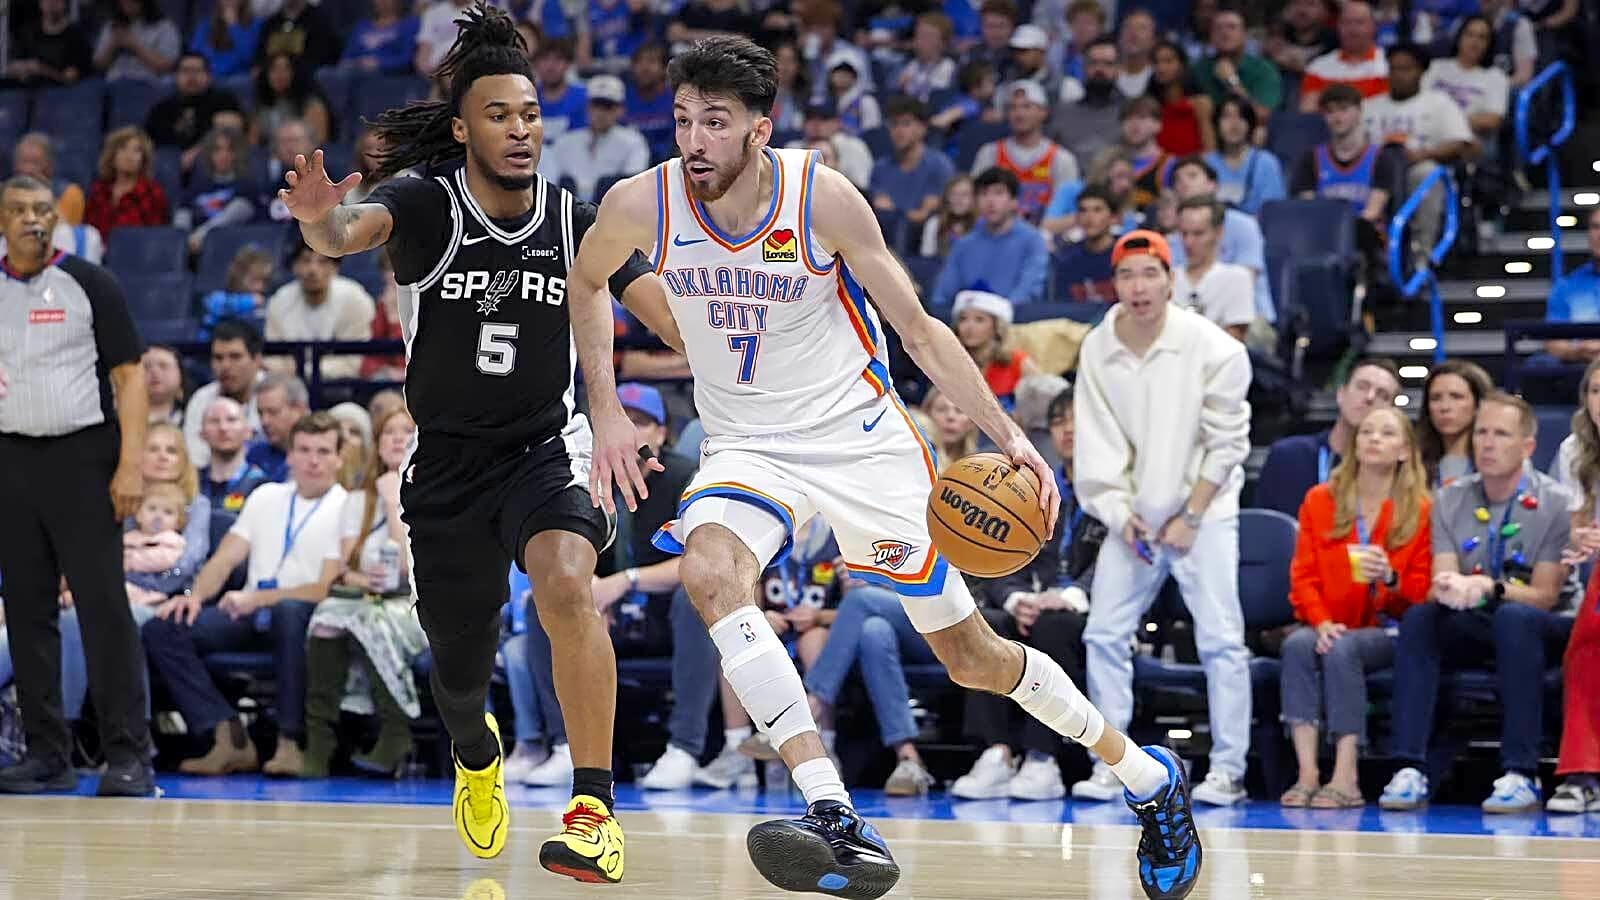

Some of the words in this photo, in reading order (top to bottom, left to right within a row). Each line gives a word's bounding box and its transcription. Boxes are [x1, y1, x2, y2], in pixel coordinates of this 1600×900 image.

[526, 249, 554, 257] LEDGER
[765, 249, 795, 259] Love's
[663, 266, 809, 303] OKLAHOMA
[708, 300, 768, 332] CITY
[476, 322, 520, 377] 5
[727, 333, 760, 384] 7
[940, 486, 1011, 543] Wilson
[875, 546, 903, 563] OKC
